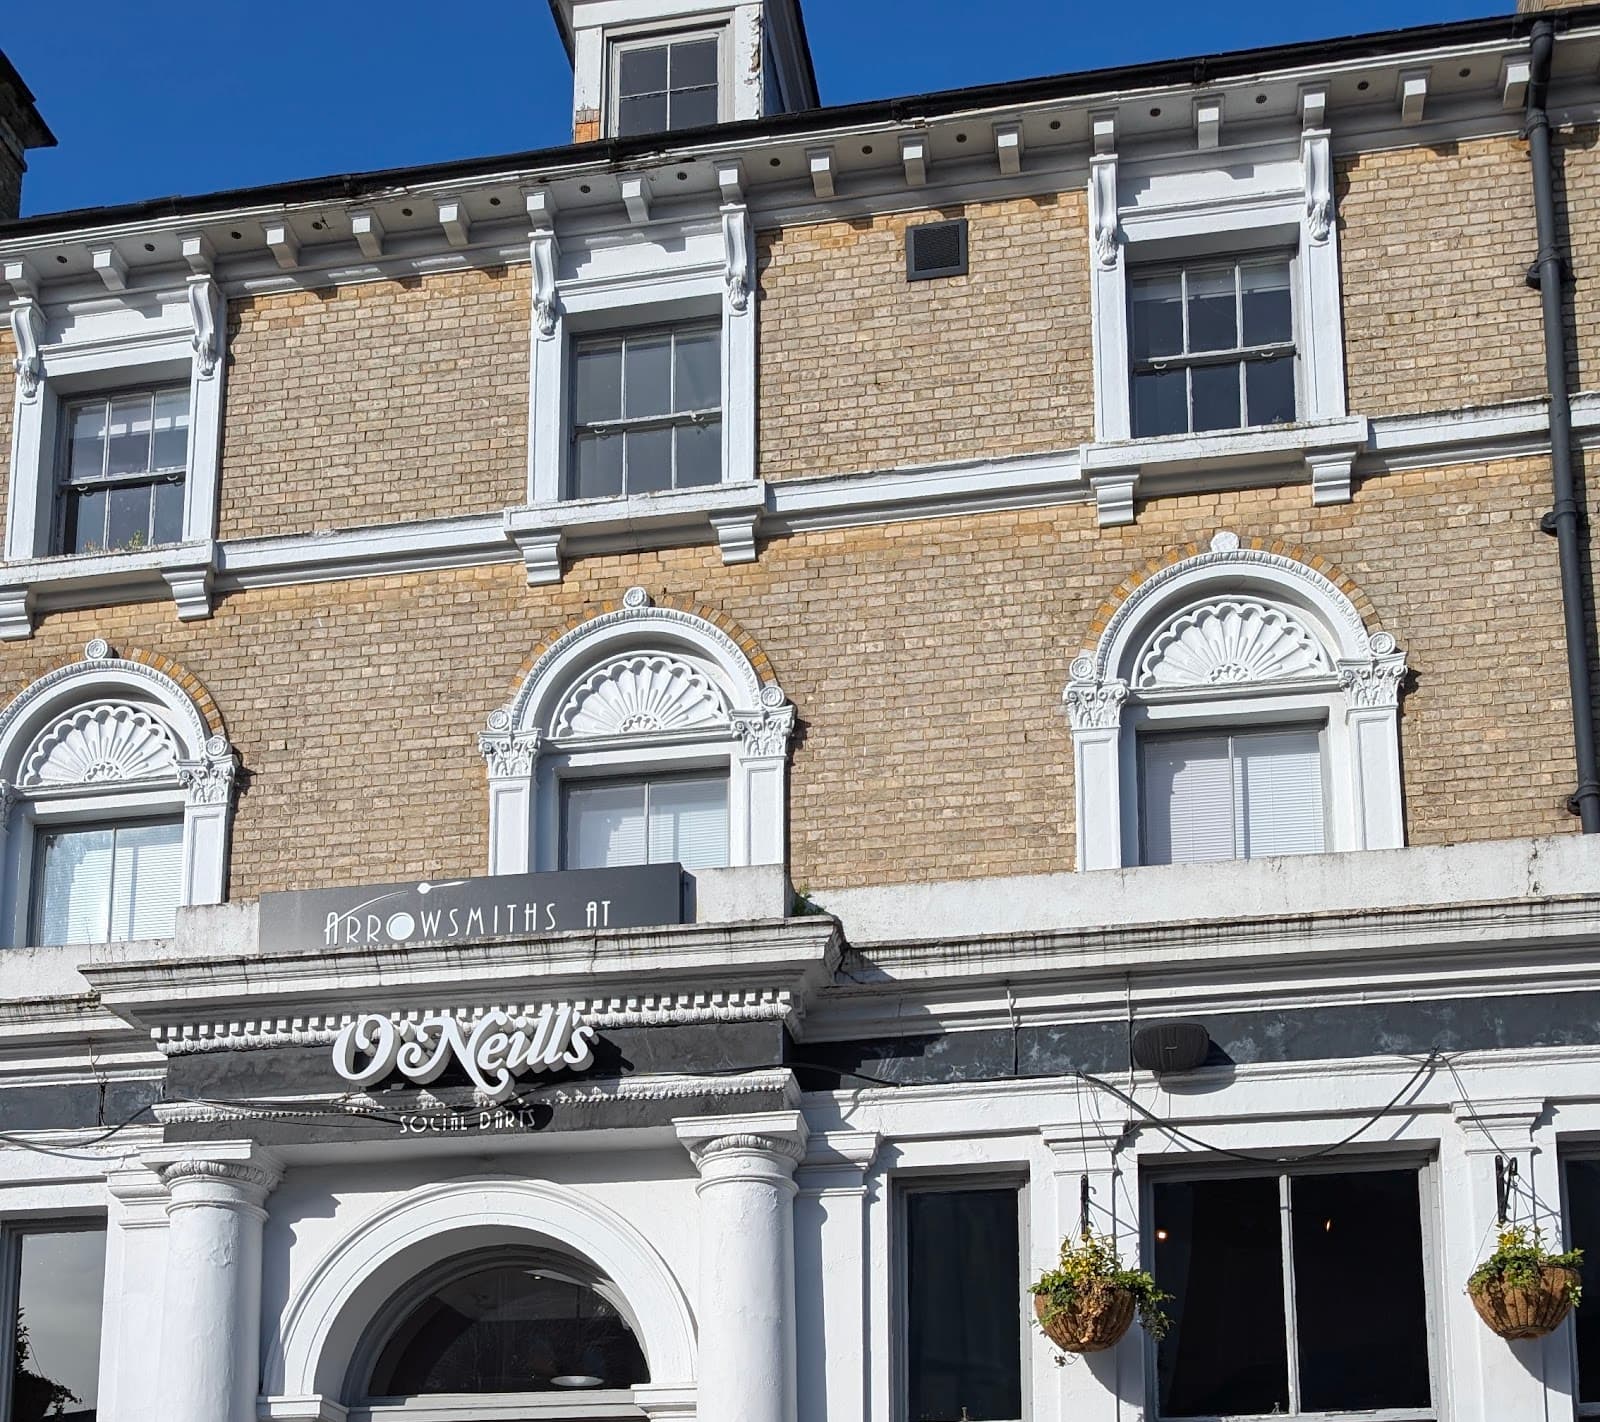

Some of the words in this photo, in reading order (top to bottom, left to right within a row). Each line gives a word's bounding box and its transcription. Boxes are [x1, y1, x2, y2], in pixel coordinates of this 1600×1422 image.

[324, 903, 556, 945] ARROWSMITHS
[586, 901, 611, 927] AT
[332, 1006, 596, 1096] O'Neill's
[399, 1112, 468, 1134] SOCIAL
[479, 1109, 536, 1130] DARTS
